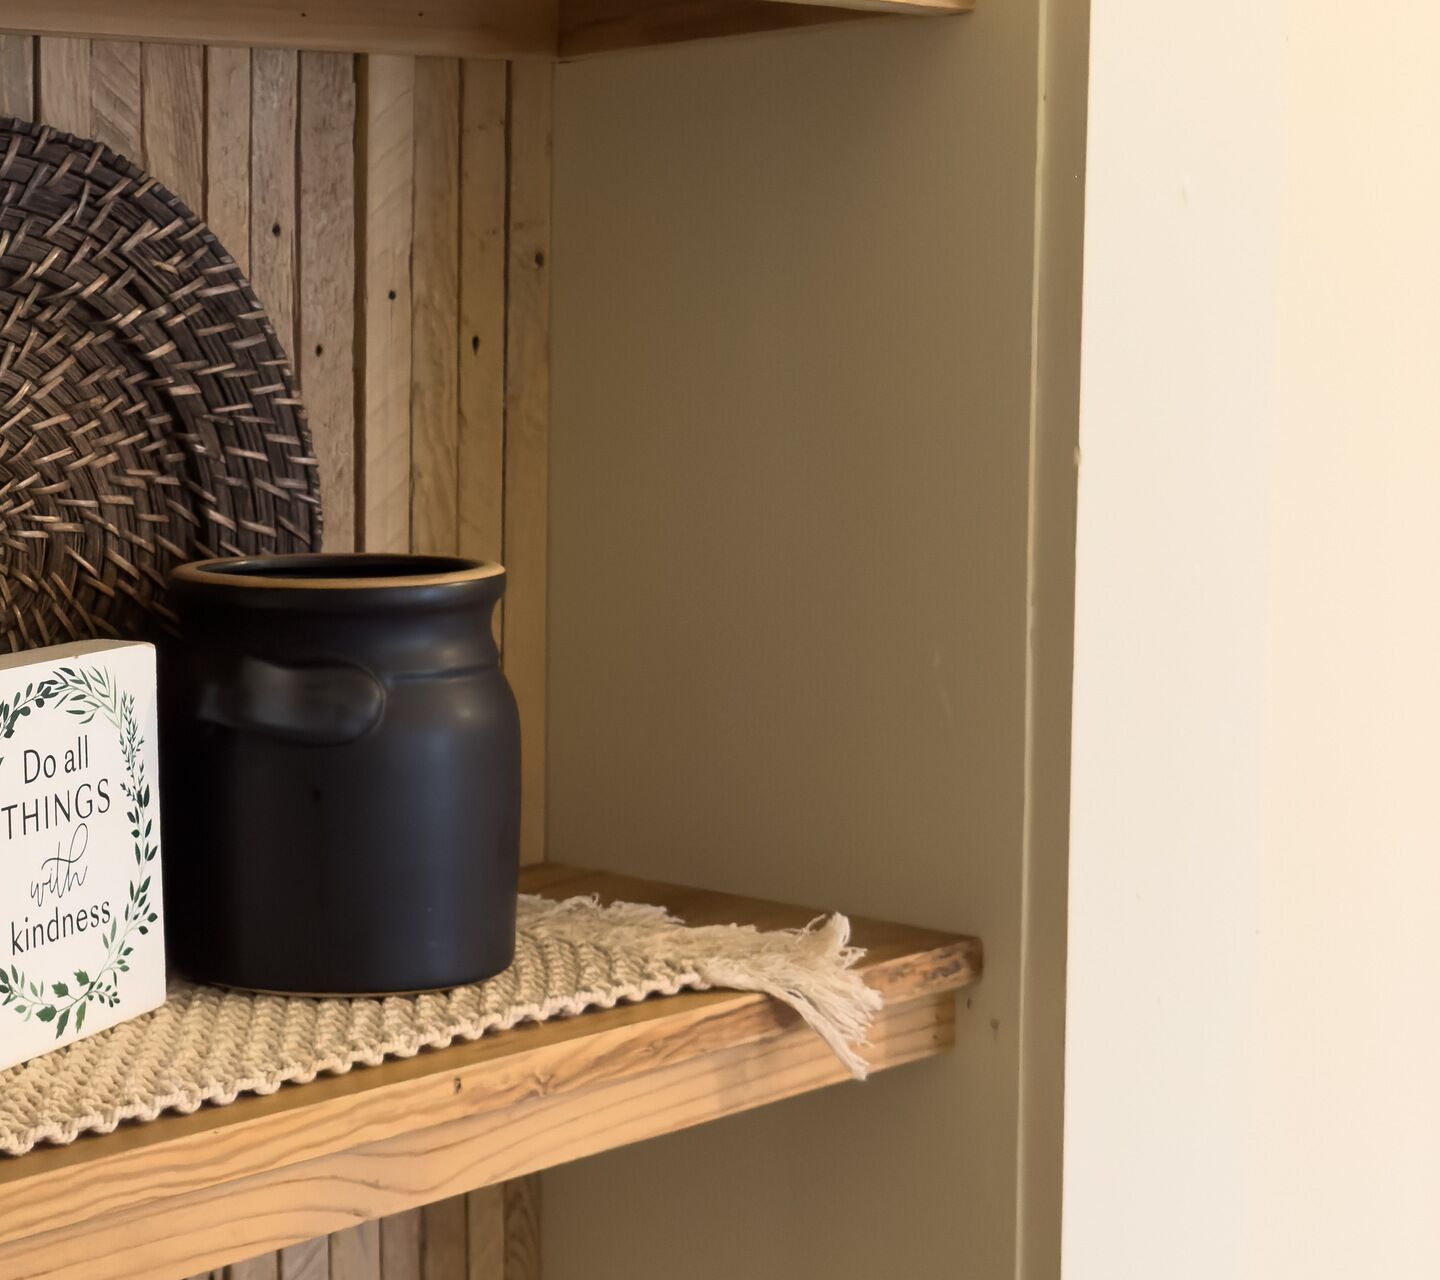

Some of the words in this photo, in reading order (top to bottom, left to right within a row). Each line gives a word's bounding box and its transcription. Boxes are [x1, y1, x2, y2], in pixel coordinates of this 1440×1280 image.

[23, 749, 56, 785] Do
[64, 734, 89, 774] all
[1, 777, 111, 840] THINGS
[30, 822, 89, 907] with
[10, 900, 111, 956] kindness
